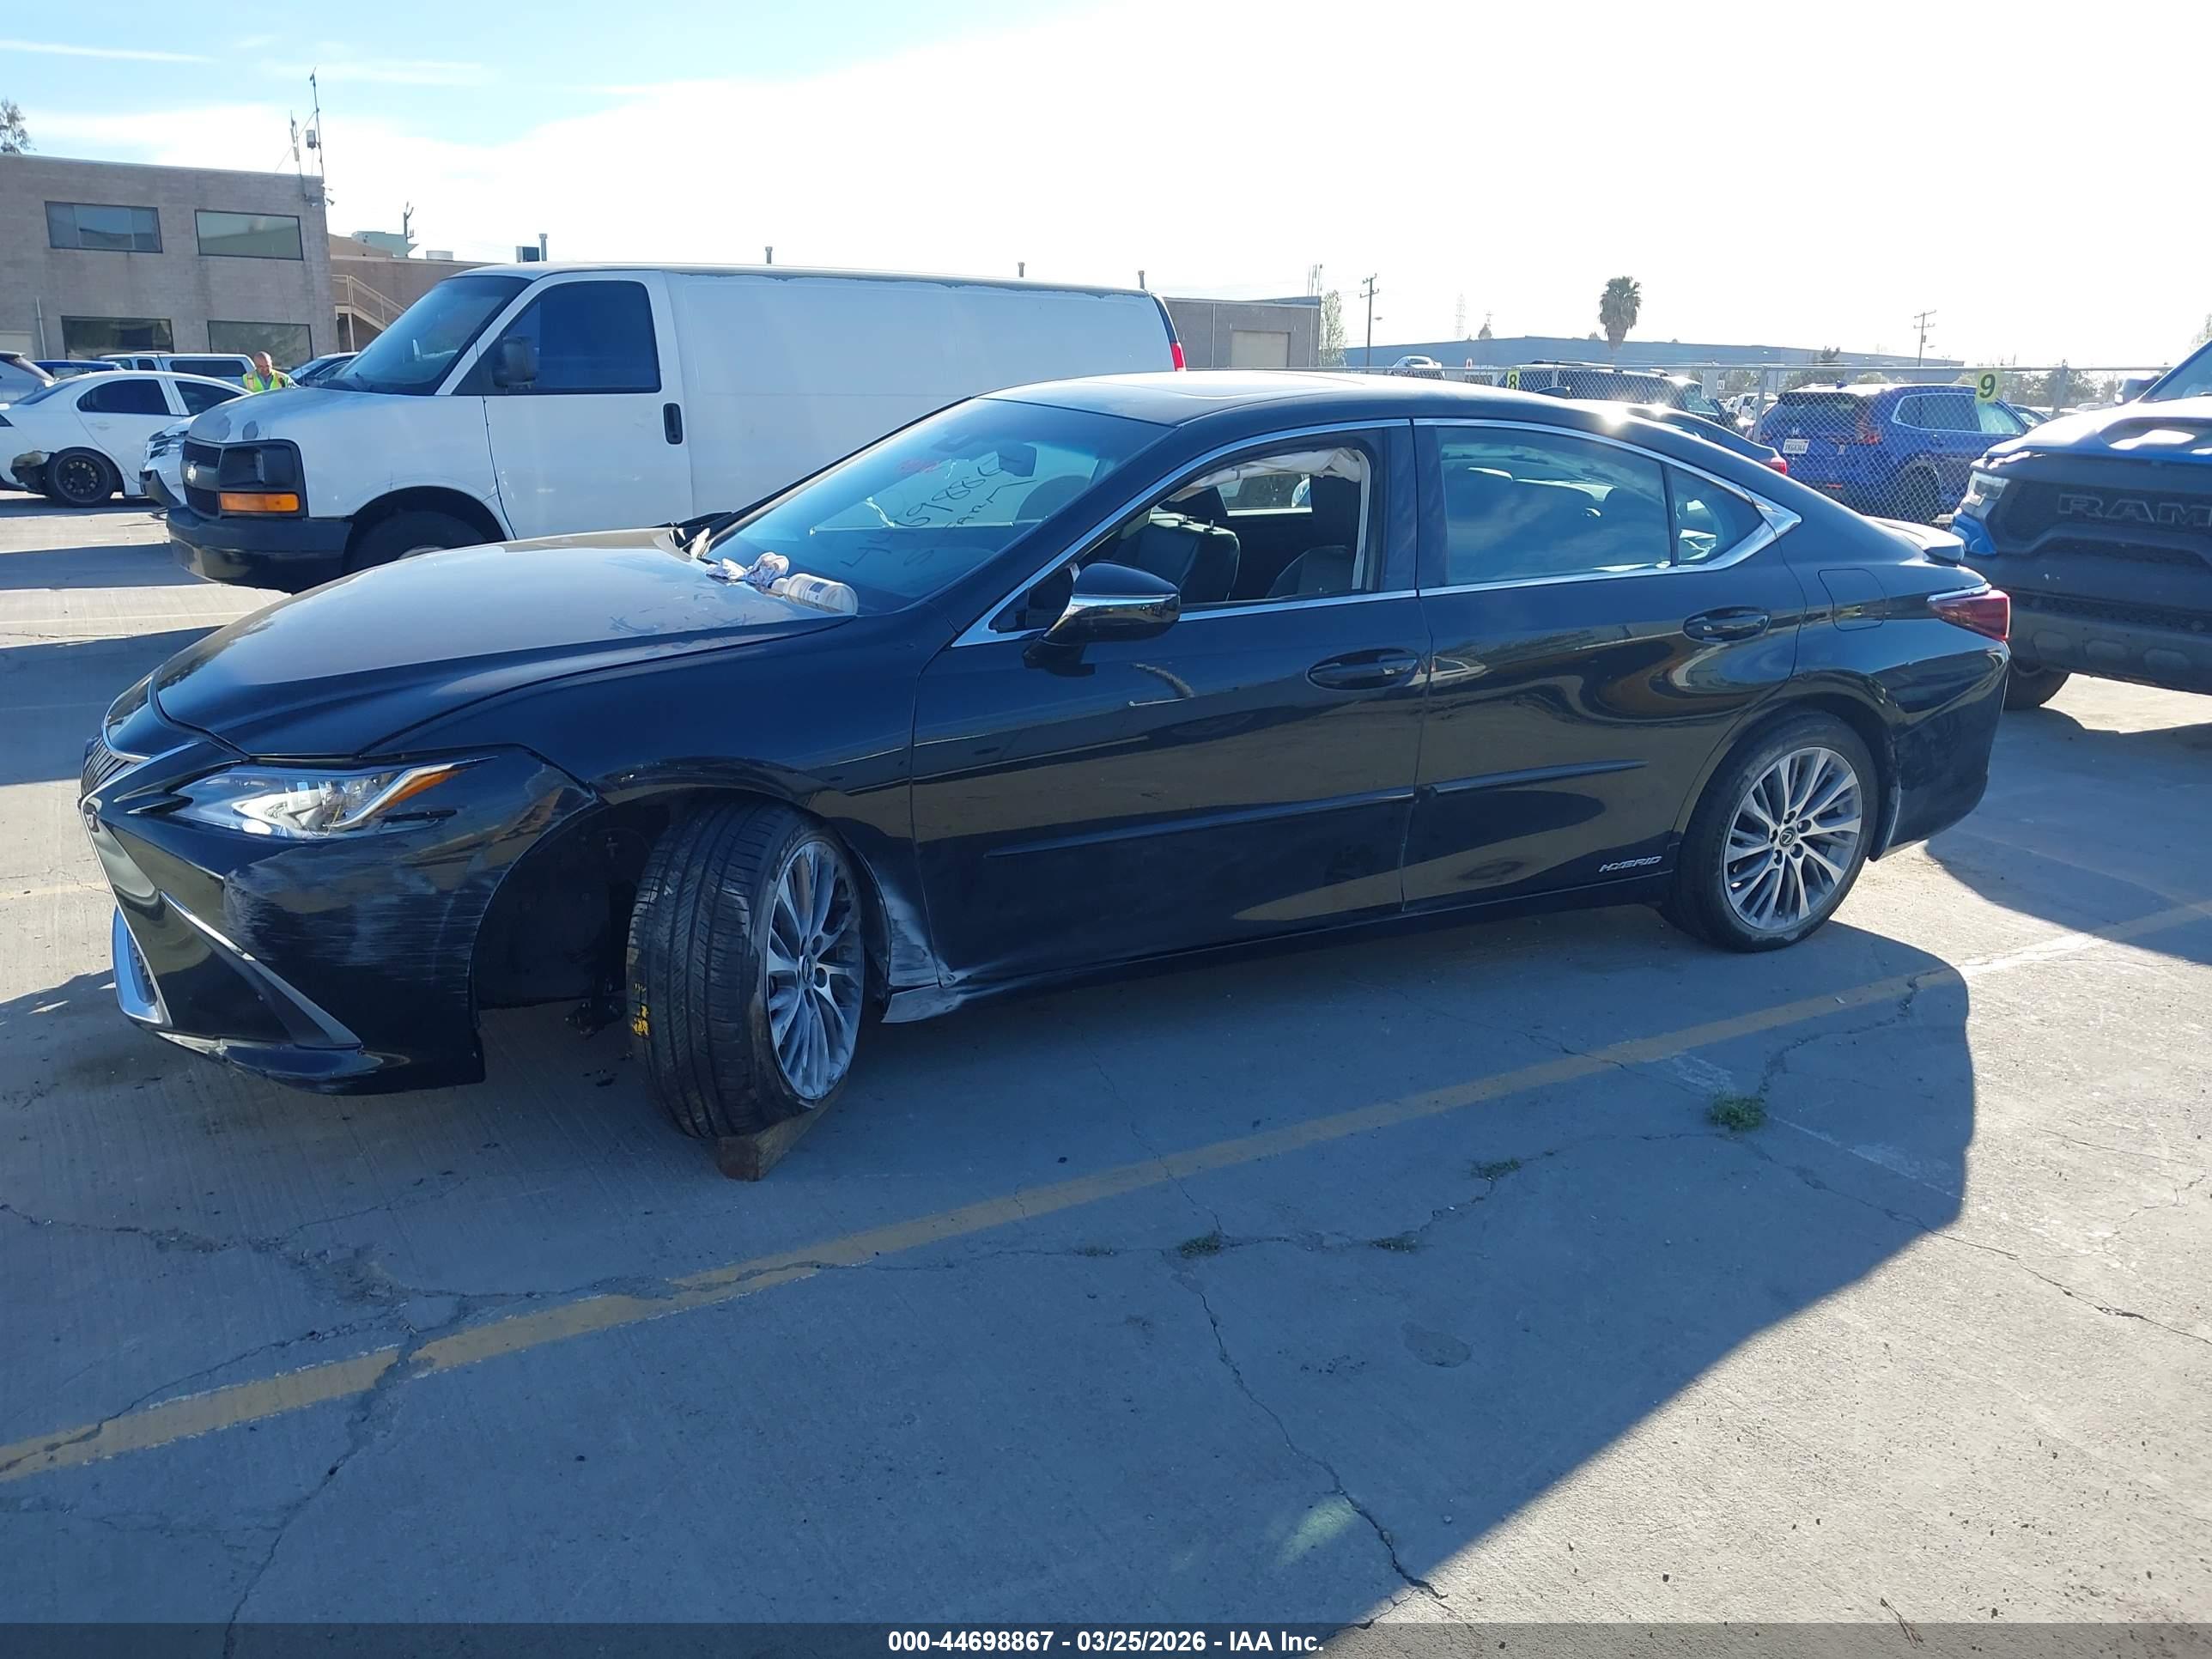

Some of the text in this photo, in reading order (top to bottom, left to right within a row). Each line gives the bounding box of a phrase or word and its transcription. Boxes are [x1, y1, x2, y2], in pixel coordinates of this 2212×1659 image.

[1508, 374, 1517, 390] 8
[1978, 374, 1996, 398] 9
[2057, 494, 2212, 527] RAM
[1598, 855, 1662, 873] HYBRID
